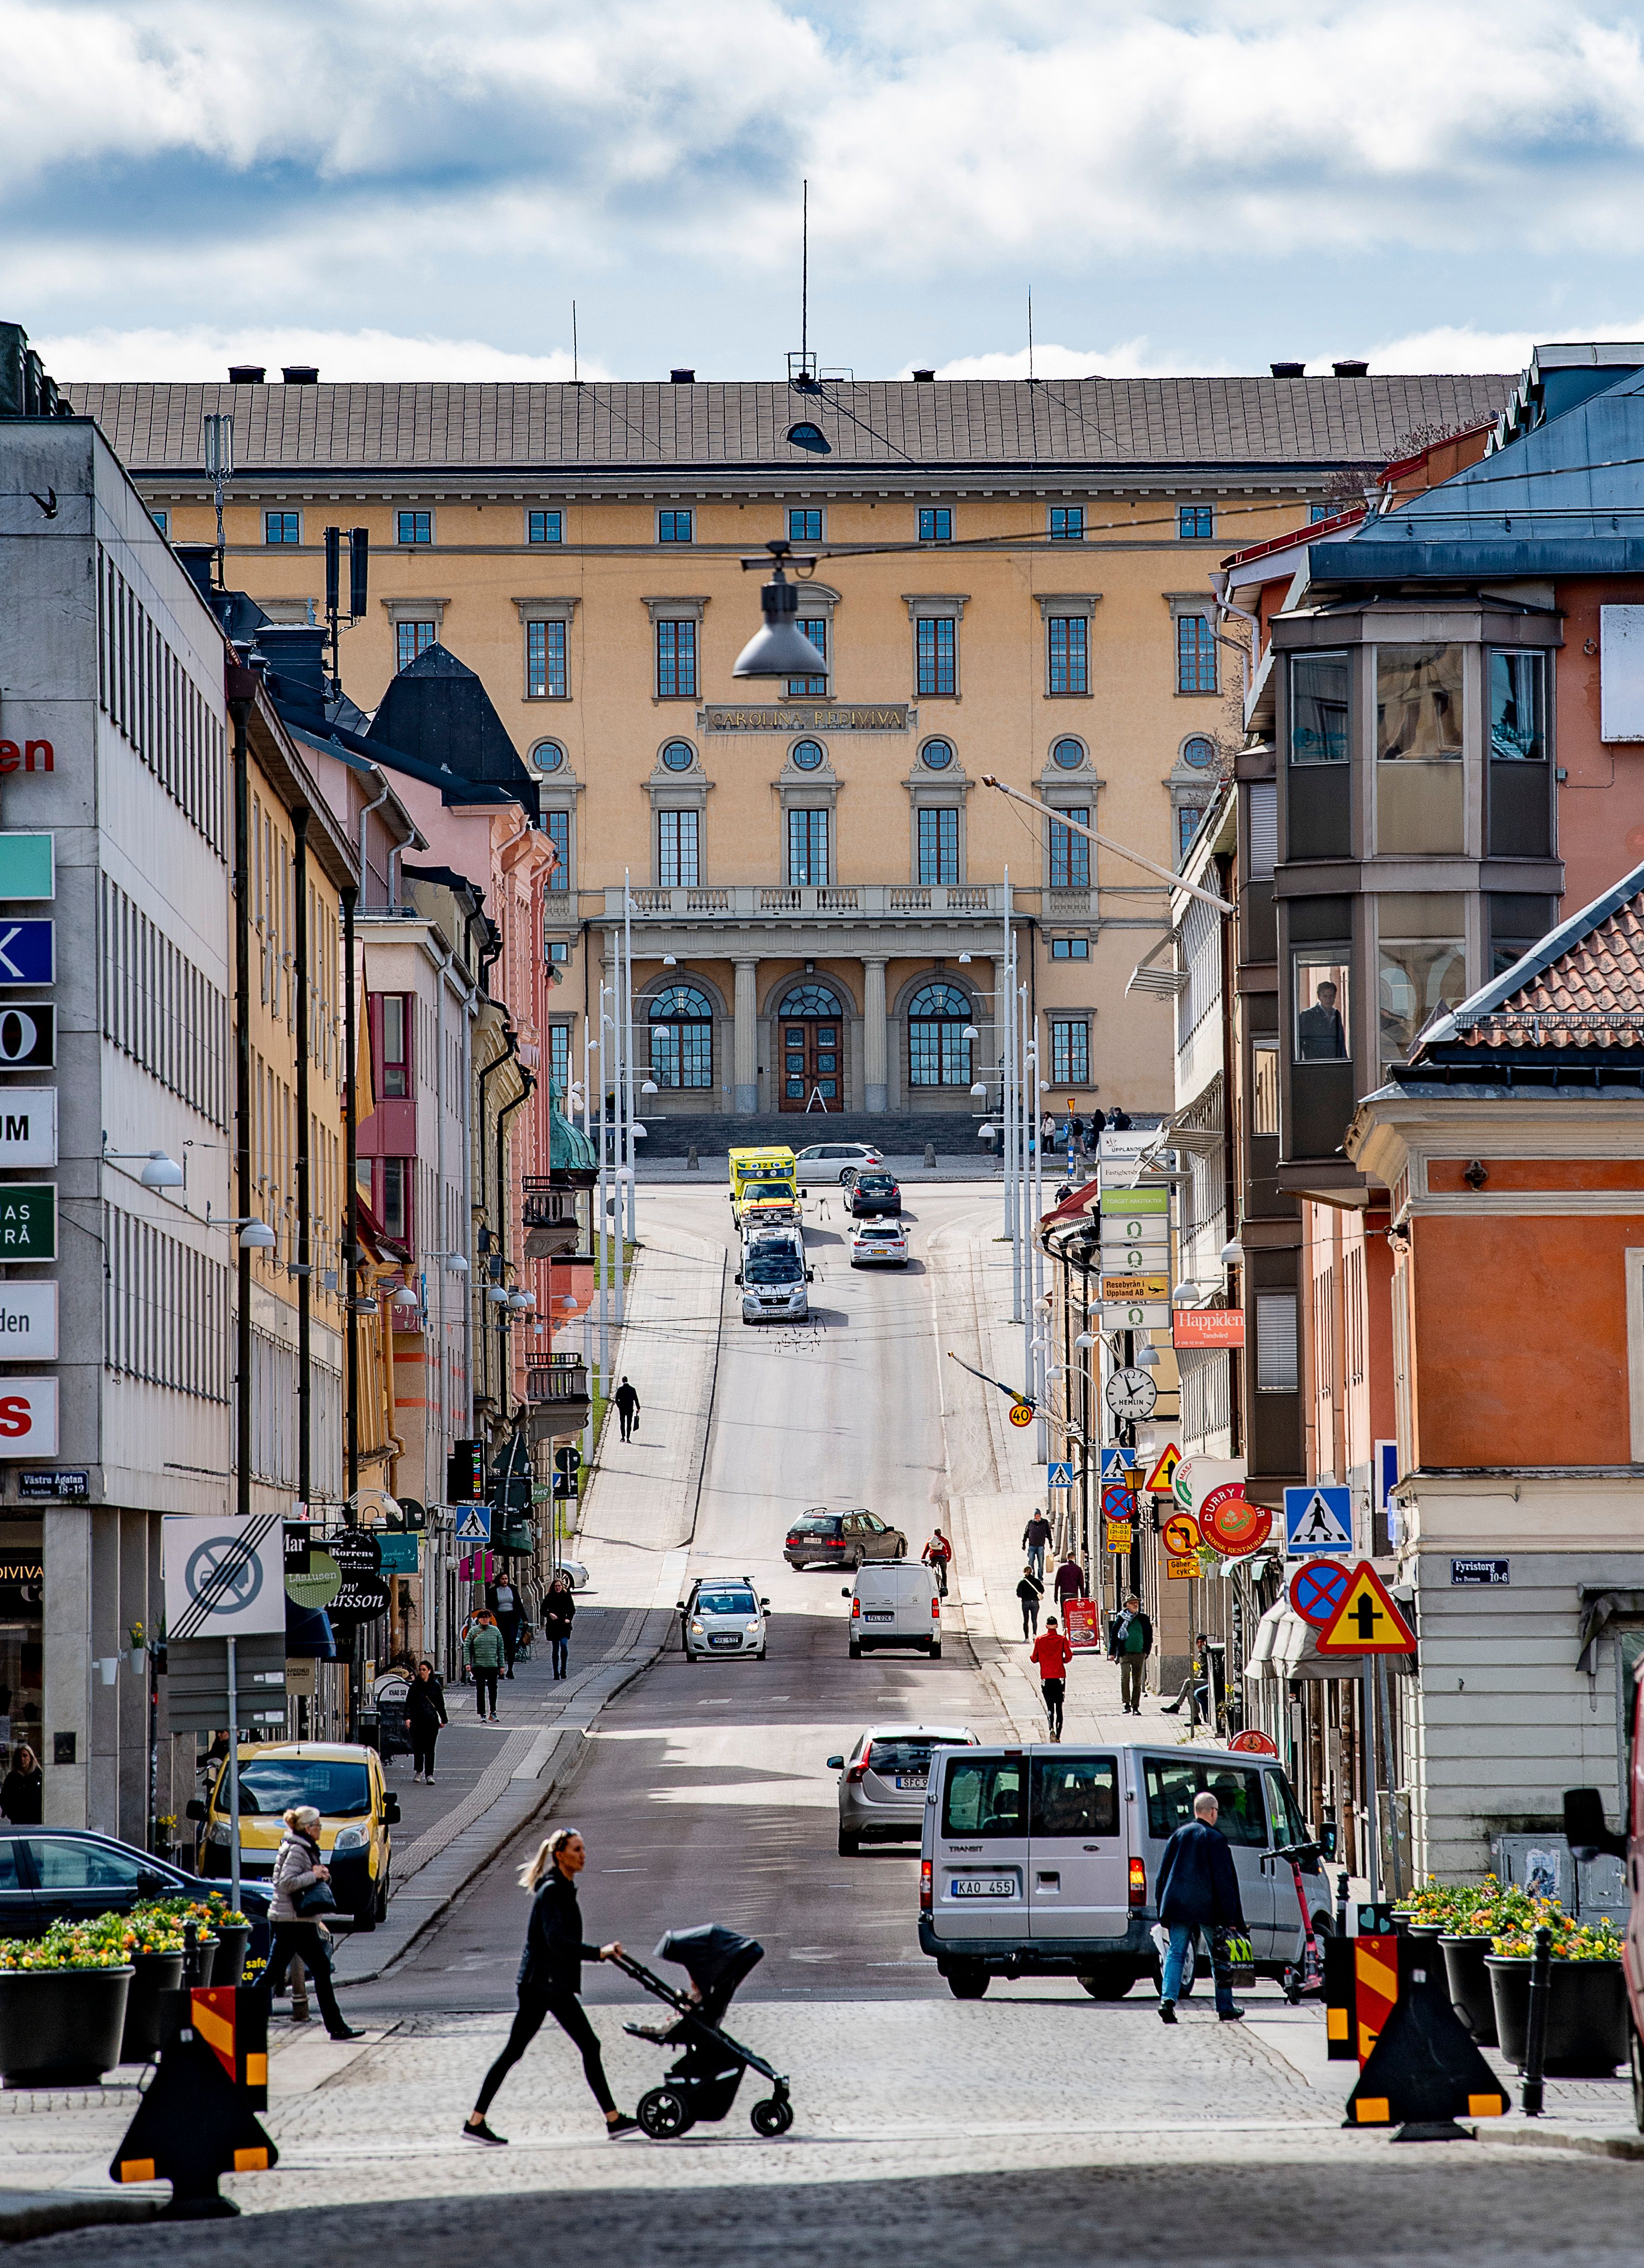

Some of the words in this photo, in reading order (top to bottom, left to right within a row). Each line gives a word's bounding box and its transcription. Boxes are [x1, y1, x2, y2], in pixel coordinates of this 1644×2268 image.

[712, 712, 804, 726] CAROLINA
[814, 711, 901, 726] REDIVIVA
[0, 1115, 29, 1140] M
[0, 1205, 30, 1220] AS
[0, 1224, 30, 1244] RÅ
[1106, 1280, 1141, 1289] Resebyrån
[1106, 1289, 1133, 1298] Uppland
[1179, 1312, 1244, 1330] Happiden
[1013, 1410, 1029, 1421] 40
[471, 1443, 481, 1498] HEMMAKVÄLL
[24, 1475, 52, 1484] Västra
[55, 1472, 83, 1486] Ågatan
[58, 1485, 84, 1494] 18-12
[1205, 1530, 1226, 1551] INDISK
[1228, 1525, 1270, 1554] RESTAURANG
[332, 1548, 374, 1557] Korrens
[1456, 1561, 1495, 1573] Fyristorg
[289, 1572, 336, 1583] Läslusen
[1490, 1573, 1508, 1582] 10-6
[326, 1595, 384, 1608] arsson
[959, 1882, 980, 1893] KAO
[989, 1882, 1011, 1893] 455
[246, 1957, 266, 1968] safe
